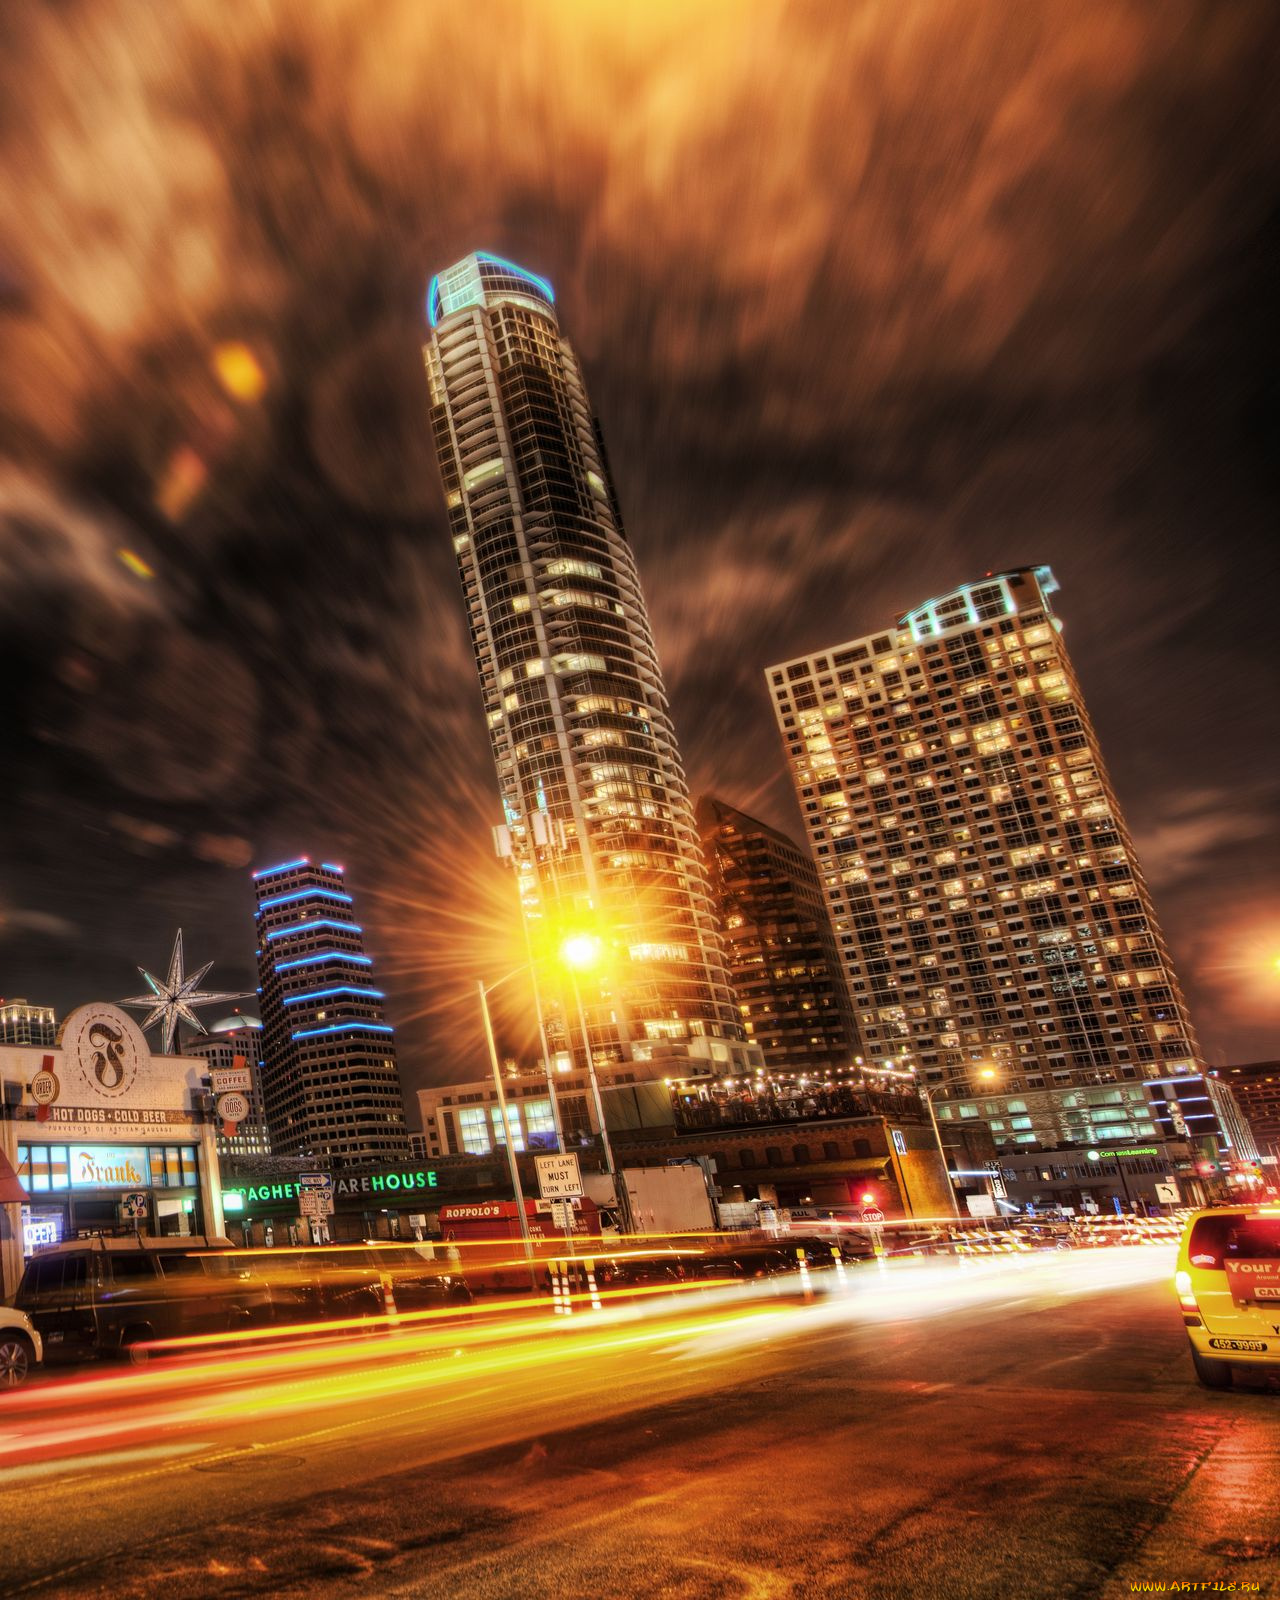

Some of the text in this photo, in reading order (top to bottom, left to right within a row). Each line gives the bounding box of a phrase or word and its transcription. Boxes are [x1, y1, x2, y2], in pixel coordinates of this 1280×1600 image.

[216, 1076, 248, 1085] COFFEE
[35, 1081, 52, 1095] ORDER
[225, 1101, 243, 1113] DOGS
[52, 1108, 167, 1123] HOT DOGS COLD BEER
[1100, 1148, 1158, 1157] ComassLearning
[540, 1159, 574, 1169] LEFT LANE
[548, 1171, 569, 1181] MUST
[543, 1183, 580, 1193] TURN LEFT
[446, 1206, 500, 1217] ROPPOLO'S
[863, 1212, 882, 1221] STOP
[25, 1223, 56, 1245] OPEN
[1227, 1262, 1273, 1273] Your
